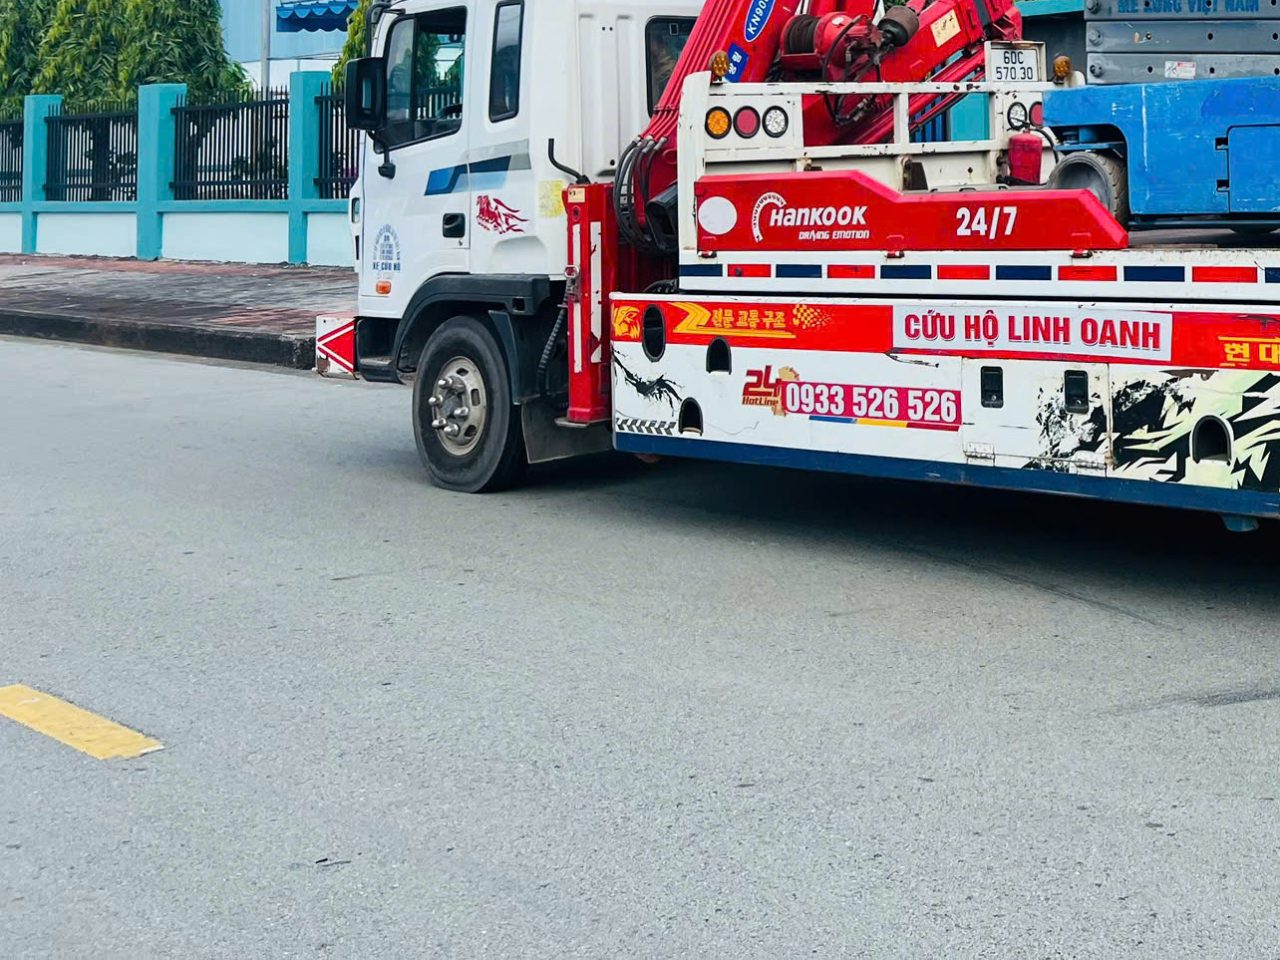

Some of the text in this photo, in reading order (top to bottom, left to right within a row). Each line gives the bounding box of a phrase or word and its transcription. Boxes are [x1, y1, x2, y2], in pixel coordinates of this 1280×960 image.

[1003, 51, 1024, 65] 60C
[995, 66, 1034, 81] 570.30
[955, 206, 1018, 240] 24/7
[736, 309, 760, 329] 교통
[762, 310, 786, 329] 구조
[904, 309, 1162, 350] CỨU HỘ LINH OANH
[785, 383, 956, 423] 0933 526 526
